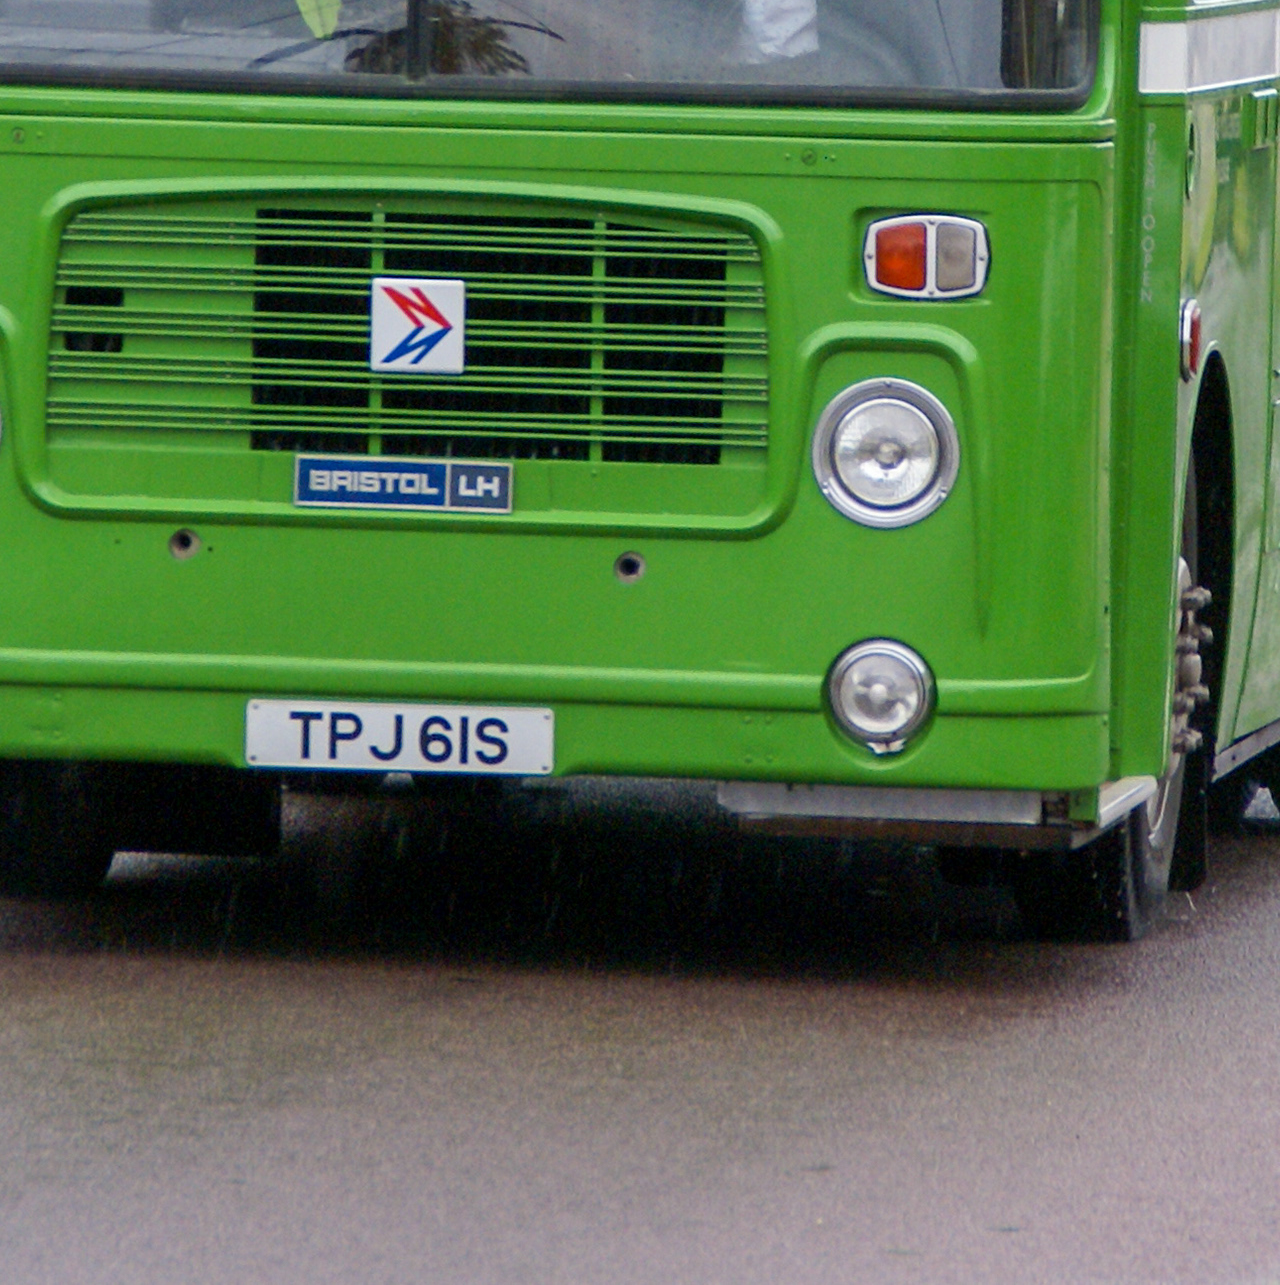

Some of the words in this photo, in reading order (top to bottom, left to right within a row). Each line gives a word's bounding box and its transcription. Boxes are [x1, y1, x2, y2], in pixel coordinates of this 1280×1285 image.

[1143, 198, 1155, 230] TO
[1141, 236, 1155, 301] OPEN
[309, 468, 439, 495] BRISTOL
[458, 474, 500, 499] LH
[289, 711, 404, 762] TPJ
